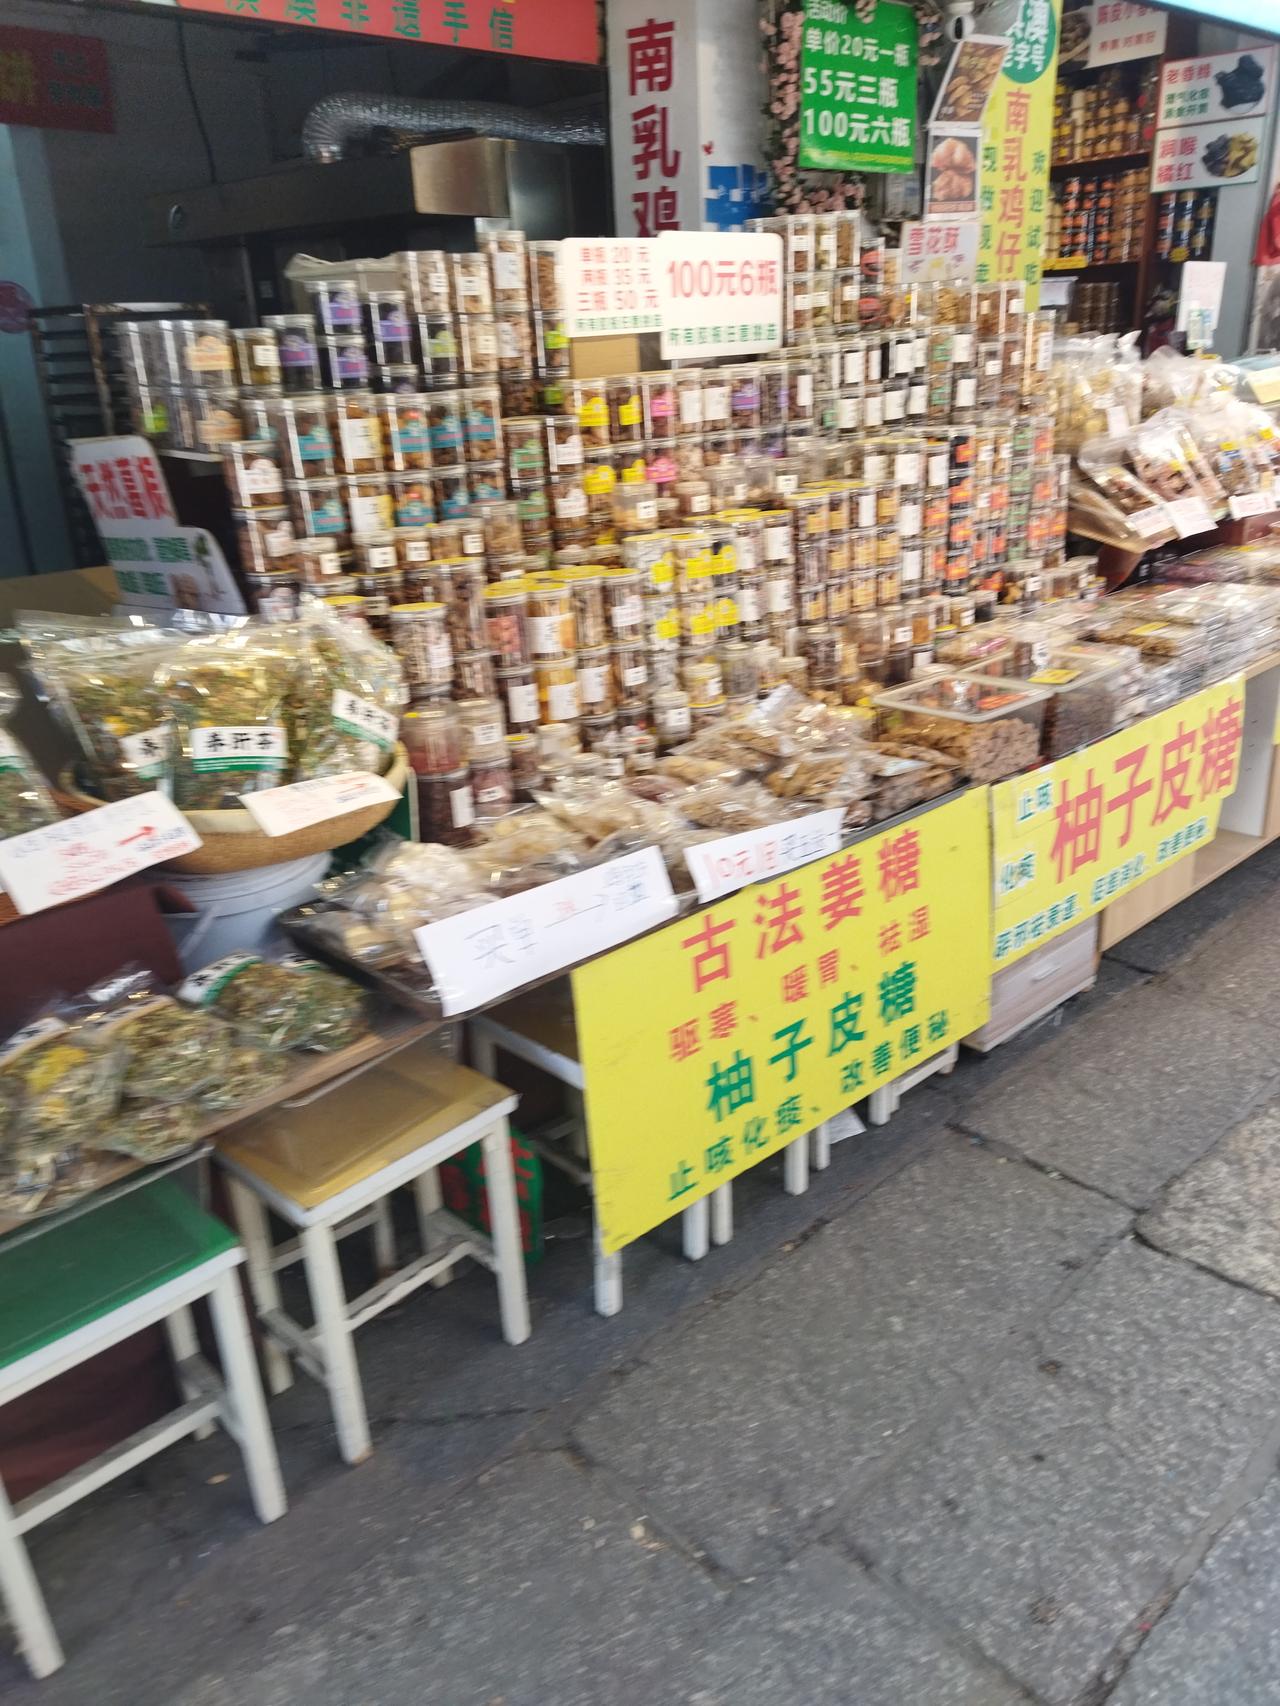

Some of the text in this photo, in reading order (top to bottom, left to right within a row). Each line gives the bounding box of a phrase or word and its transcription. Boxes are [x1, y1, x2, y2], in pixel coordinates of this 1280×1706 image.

[803, 67, 900, 108] 55元三瓶
[805, 27, 910, 67] 单价20元一瓶
[626, 18, 681, 236] 南乳鸡
[803, 109, 911, 148] 100元六瓶
[995, 89, 1031, 281] 南乳鸡仔
[666, 260, 778, 298] 100元6瓶
[908, 226, 961, 256] 雪花酥
[1024, 150, 1046, 285] 欢迎试吃
[1050, 697, 1244, 885] 柚子皮糖
[681, 829, 921, 993] 古法姜糖
[705, 960, 918, 1123] 柚子皮糖
